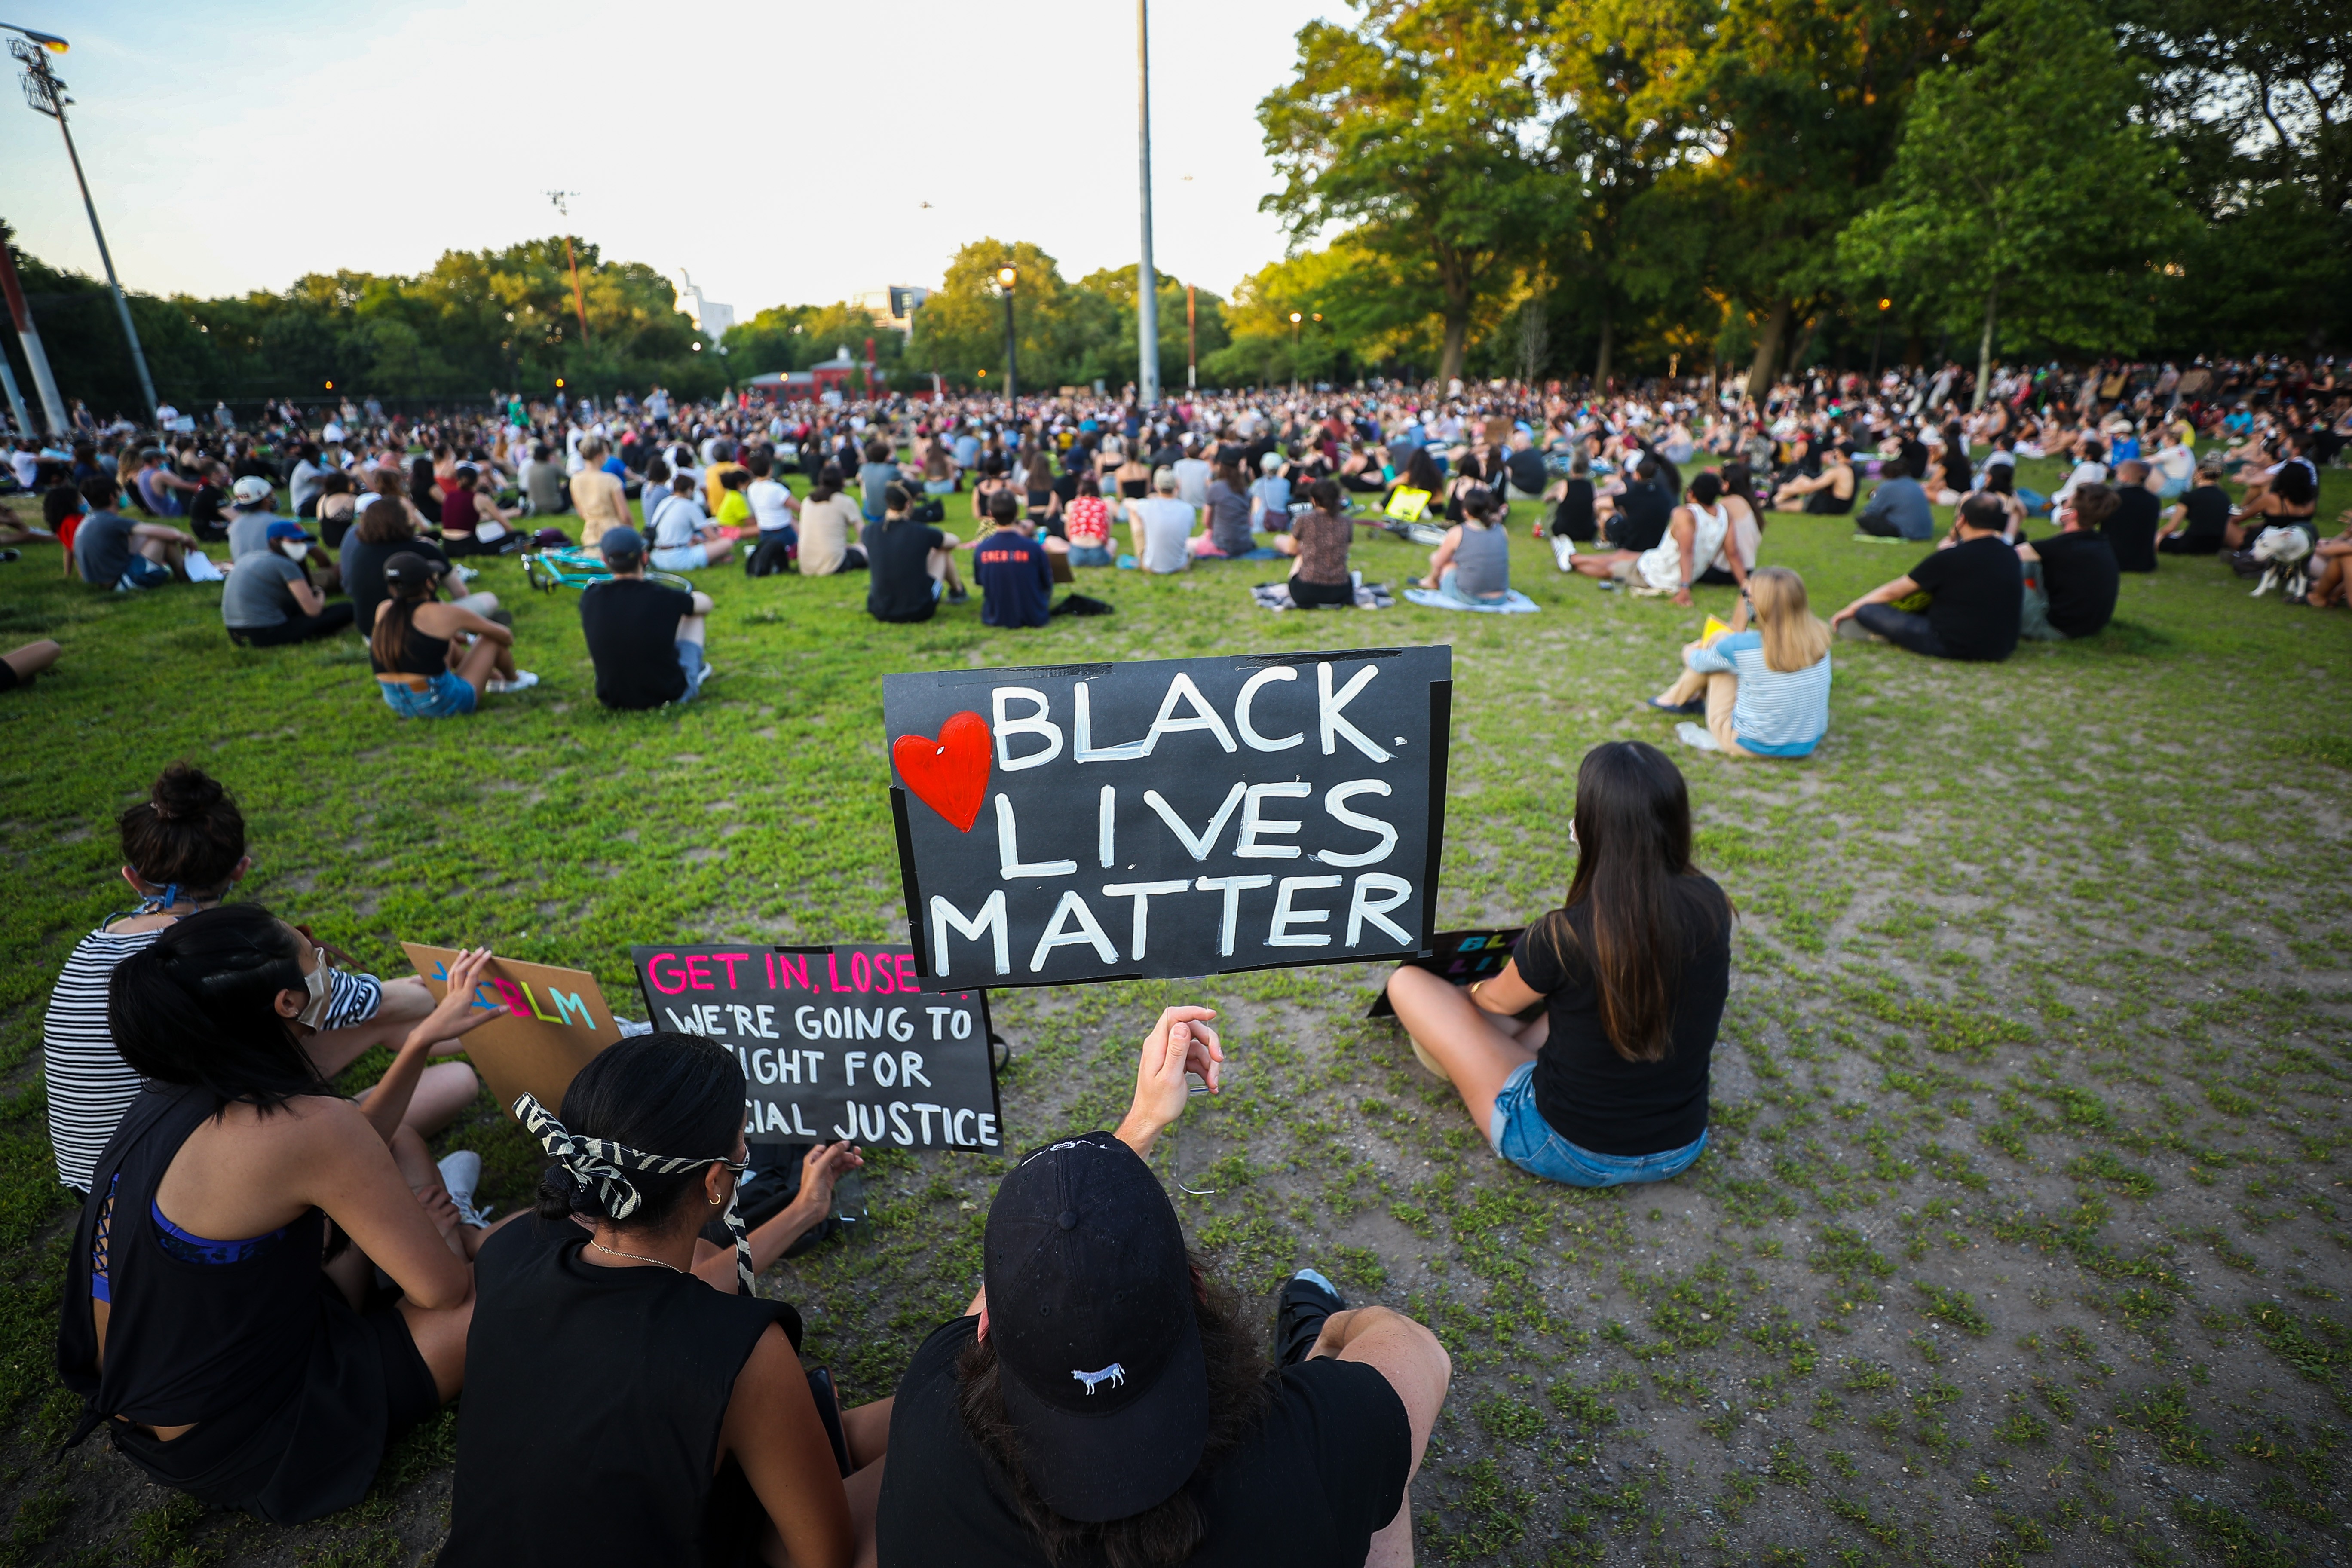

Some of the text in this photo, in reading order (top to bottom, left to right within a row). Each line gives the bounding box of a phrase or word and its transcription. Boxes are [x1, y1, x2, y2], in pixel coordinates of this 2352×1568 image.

[992, 661, 1397, 772] BLACK
[994, 779, 1399, 880] LIVES
[929, 872, 1414, 978] MATTER
[648, 952, 749, 995] GET
[765, 952, 820, 995] IN,
[665, 1003, 972, 1042] WE'RE GOING TO
[720, 1044, 932, 1088] IGHT FOR
[833, 1100, 999, 1147] JUSTICE
